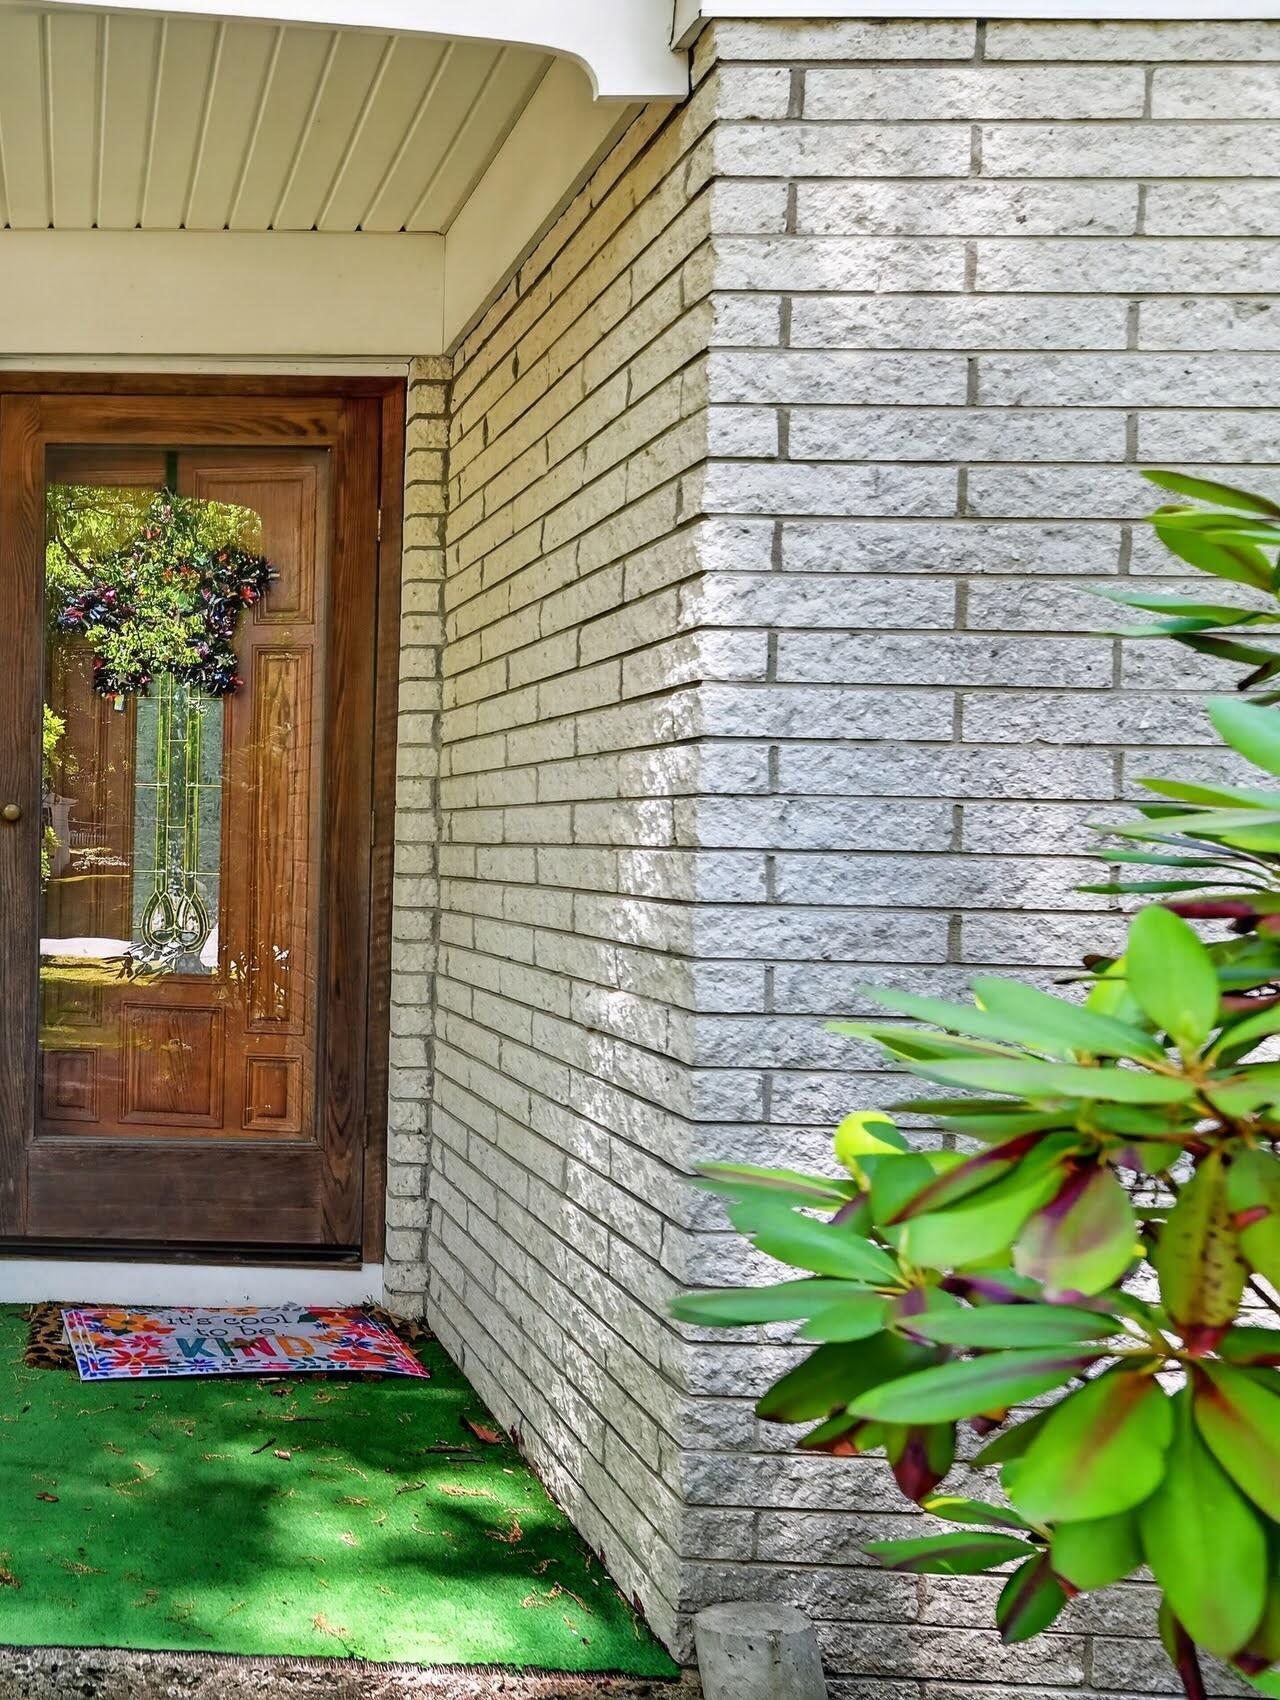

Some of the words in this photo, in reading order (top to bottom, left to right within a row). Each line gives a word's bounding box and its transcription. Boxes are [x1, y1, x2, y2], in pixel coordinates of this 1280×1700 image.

[168, 1314, 212, 1326] it's
[223, 1313, 293, 1326] cool
[195, 1327, 229, 1337] to
[239, 1325, 276, 1337] be
[176, 1336, 315, 1358] KIND
